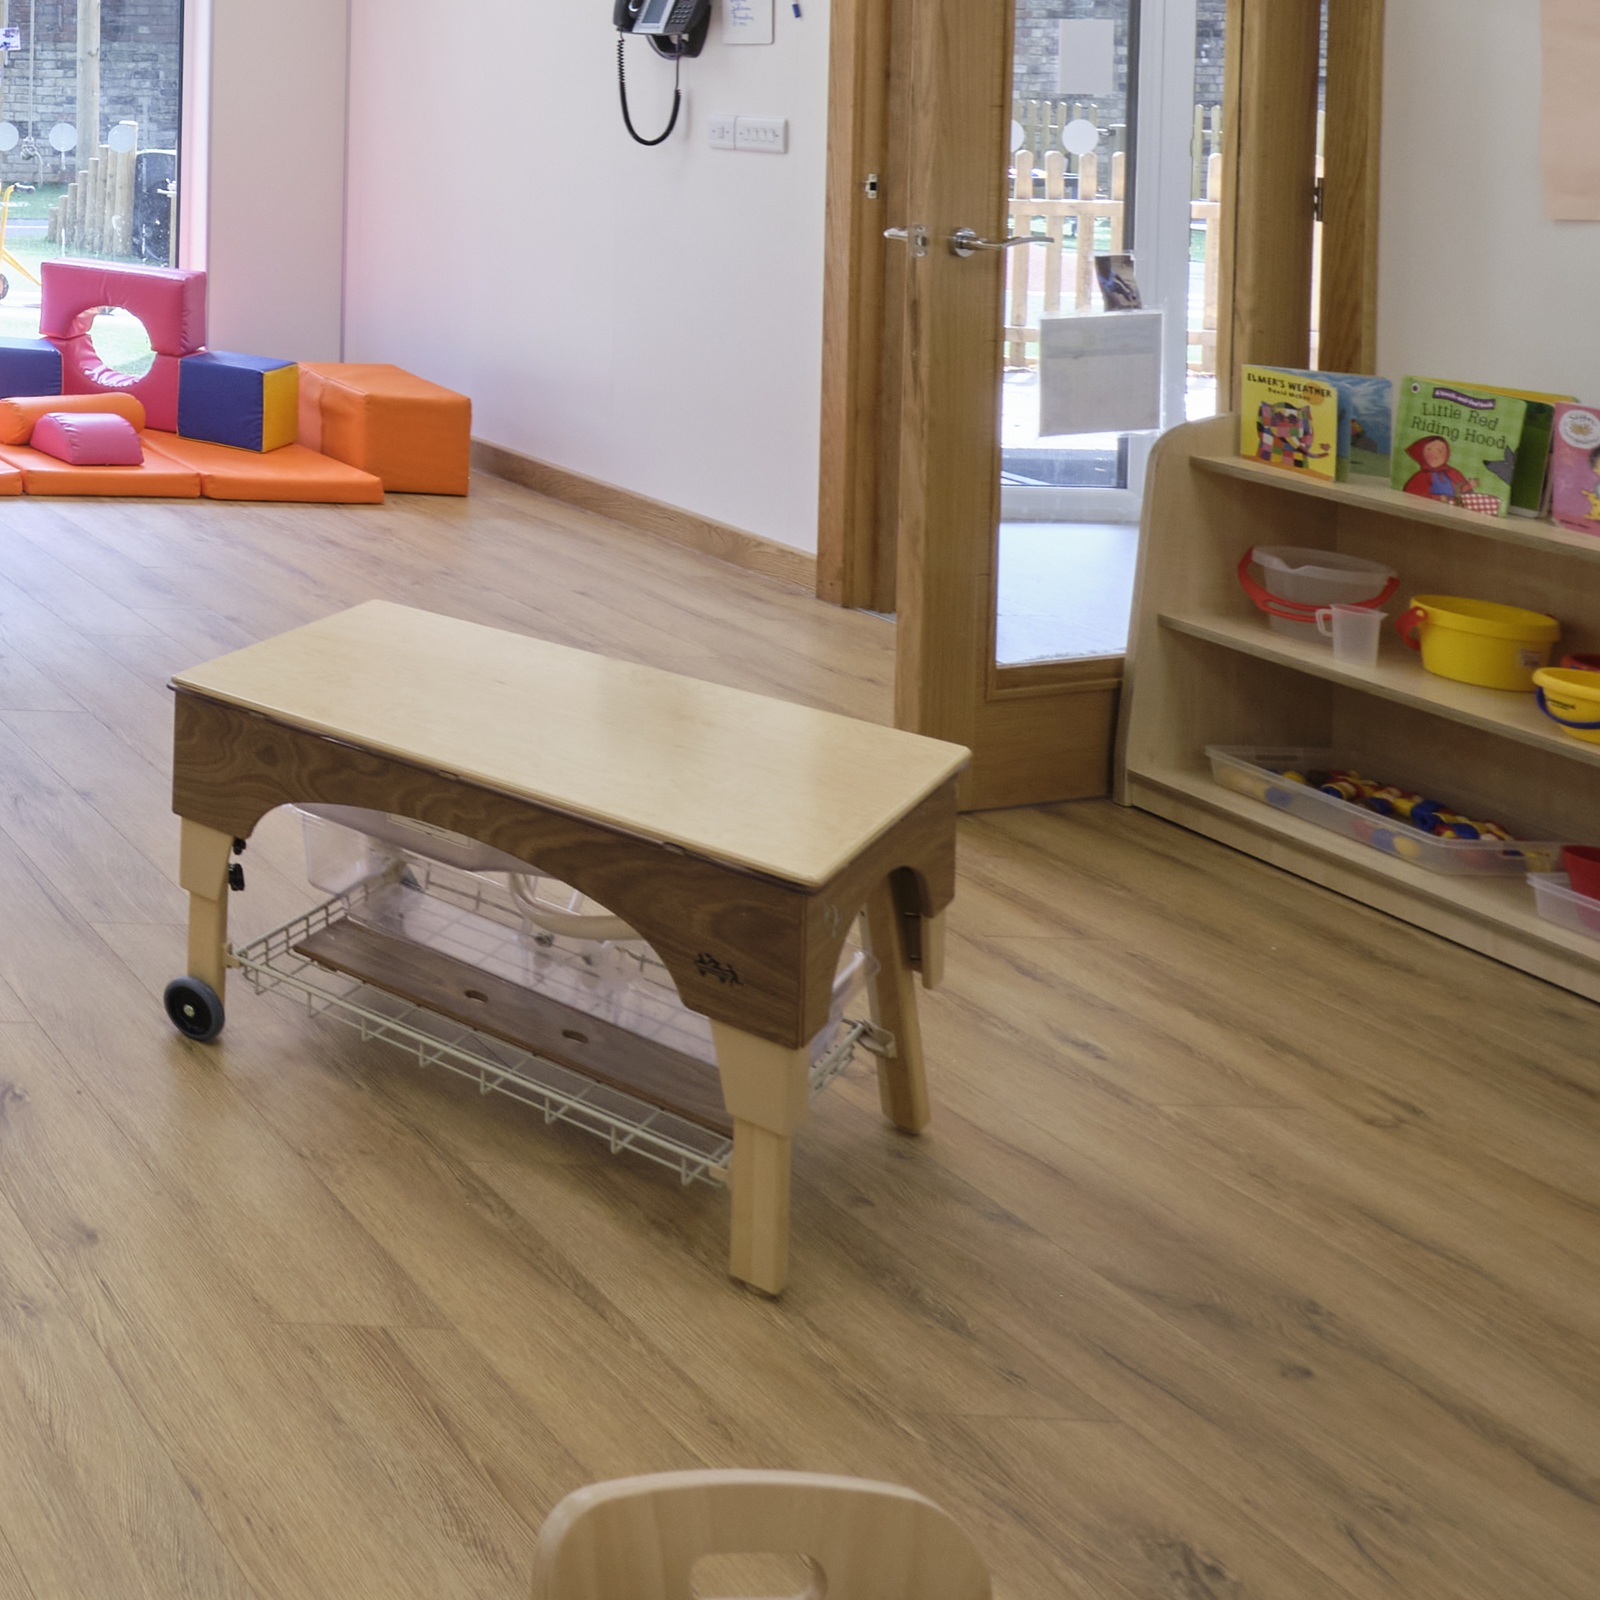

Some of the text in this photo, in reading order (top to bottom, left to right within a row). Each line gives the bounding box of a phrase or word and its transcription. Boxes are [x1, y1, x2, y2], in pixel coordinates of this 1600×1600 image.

[1247, 373, 1332, 398] ELMER'S WEATHER
[1422, 402, 1499, 431] Little Red
[1411, 416, 1506, 449] Riding Hood
